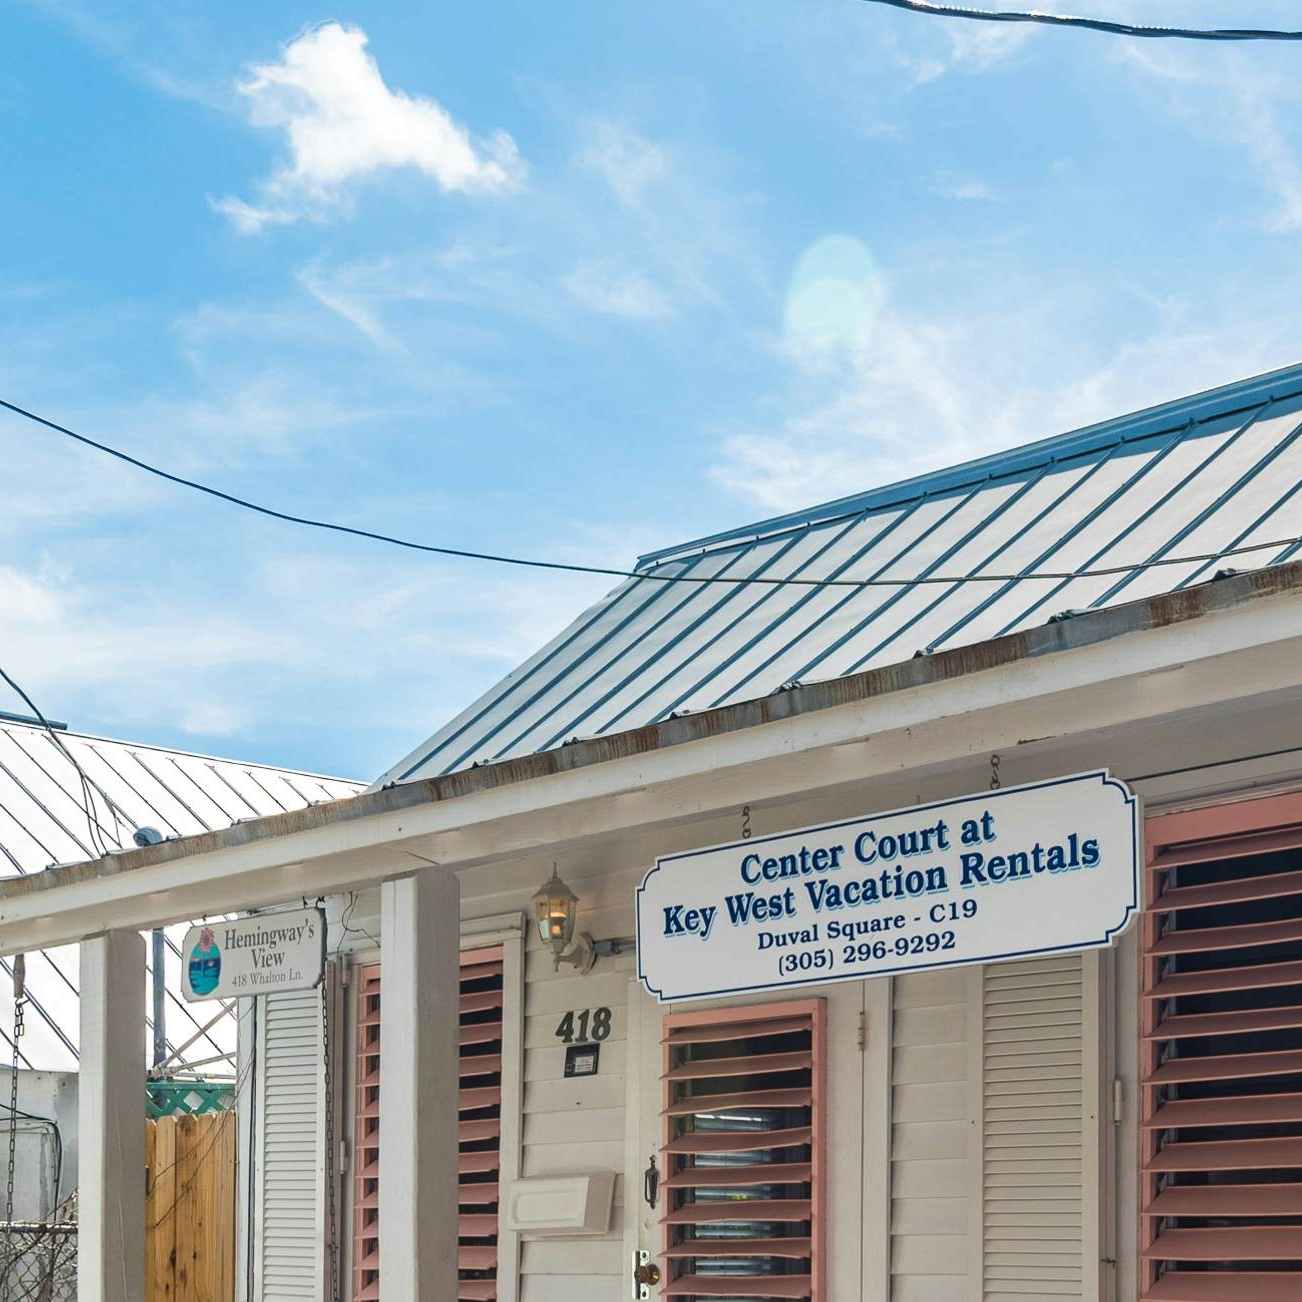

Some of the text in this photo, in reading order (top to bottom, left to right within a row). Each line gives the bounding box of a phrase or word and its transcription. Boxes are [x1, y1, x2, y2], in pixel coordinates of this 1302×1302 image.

[740, 810, 996, 886] Center Court at
[663, 832, 1101, 941] Key West Vacation Rentals
[224, 918, 315, 950] Hemingway's
[757, 924, 819, 951] Duval
[827, 912, 907, 944] Square
[929, 899, 979, 924] C19
[251, 949, 286, 969] View
[777, 931, 956, 977] (305) 296-9292
[231, 968, 304, 987] 418 Whalton Ln.
[555, 1007, 612, 1043] 418
